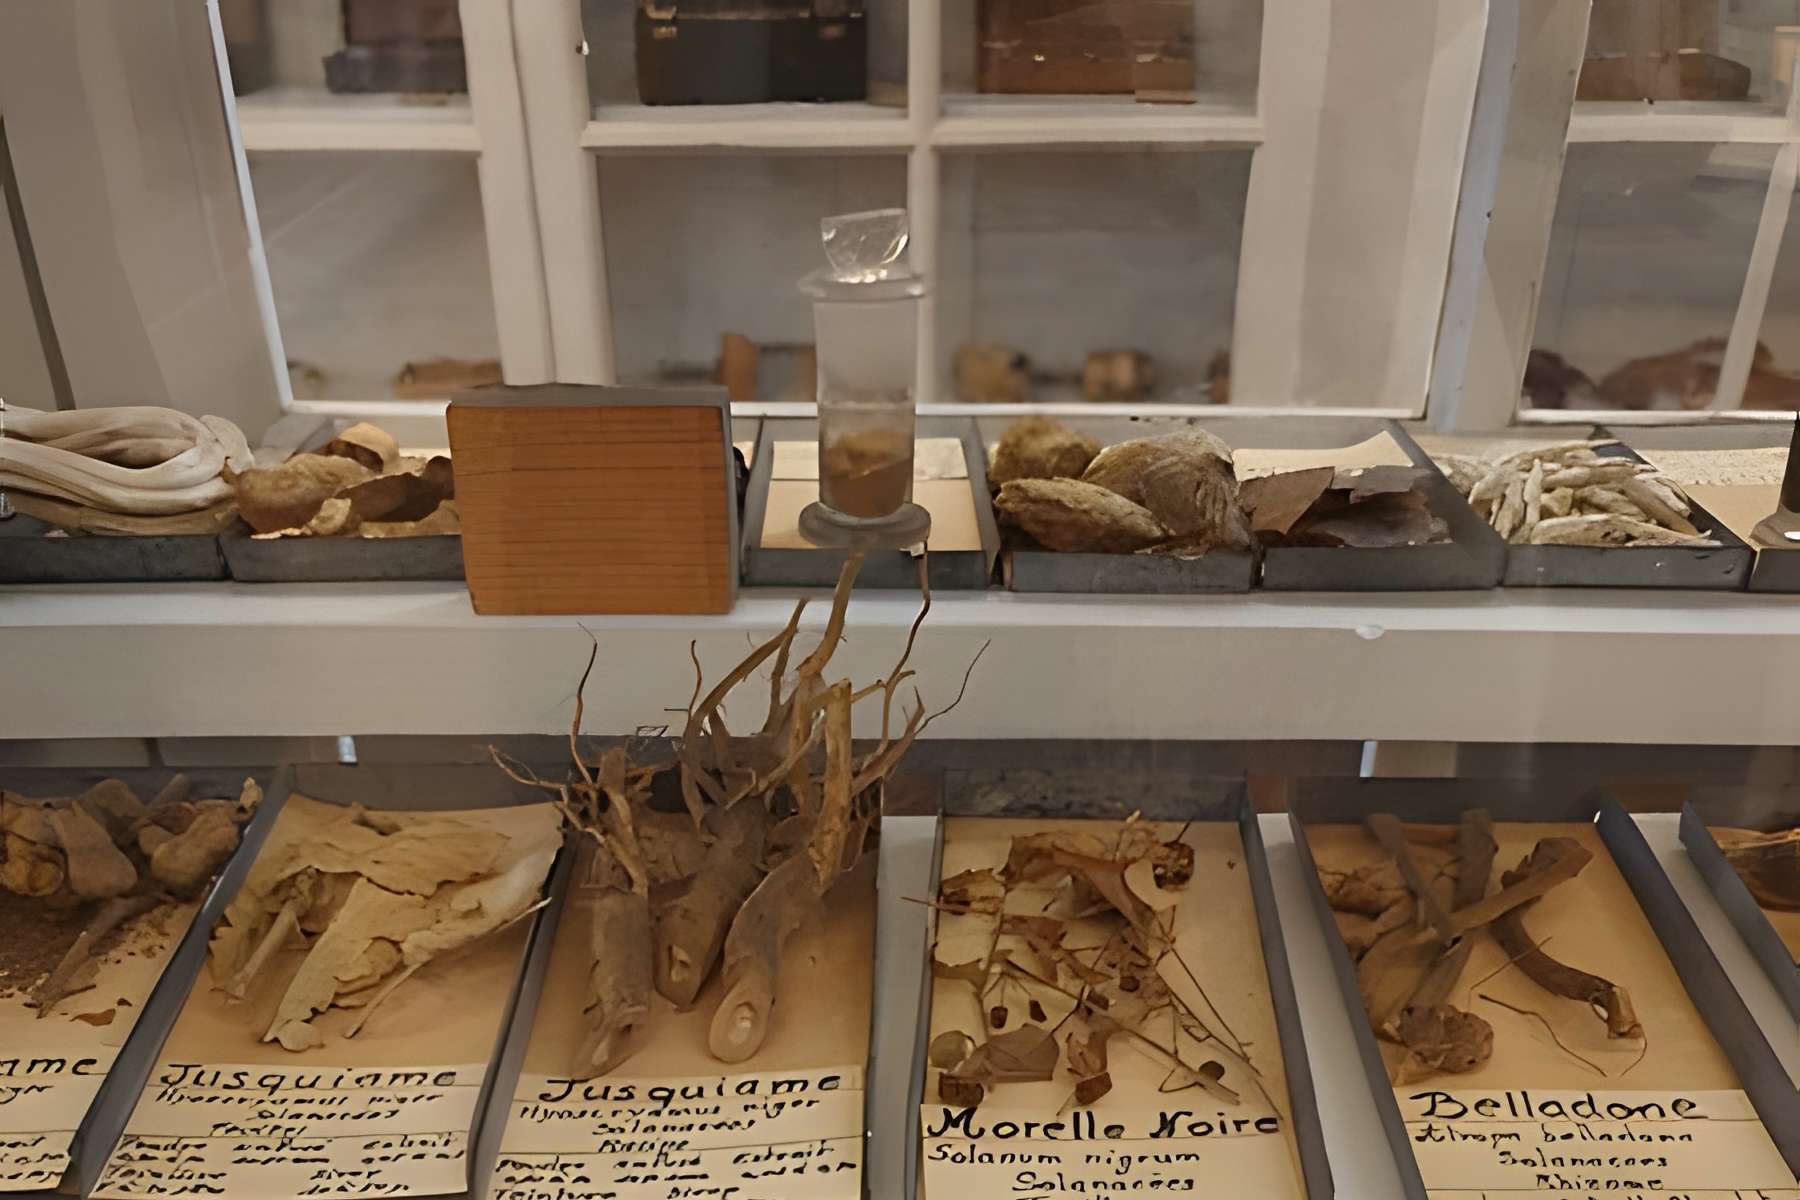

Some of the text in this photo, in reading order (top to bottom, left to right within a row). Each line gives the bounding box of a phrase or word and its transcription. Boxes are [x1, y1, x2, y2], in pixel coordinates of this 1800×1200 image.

[160, 1063, 456, 1096] Jusquiame
[539, 1075, 841, 1110] Jusquiame
[1409, 1091, 1708, 1120] Belladone
[927, 1107, 1279, 1140] Morelle Noire
[928, 1143, 1200, 1175] Solanum nigrum
